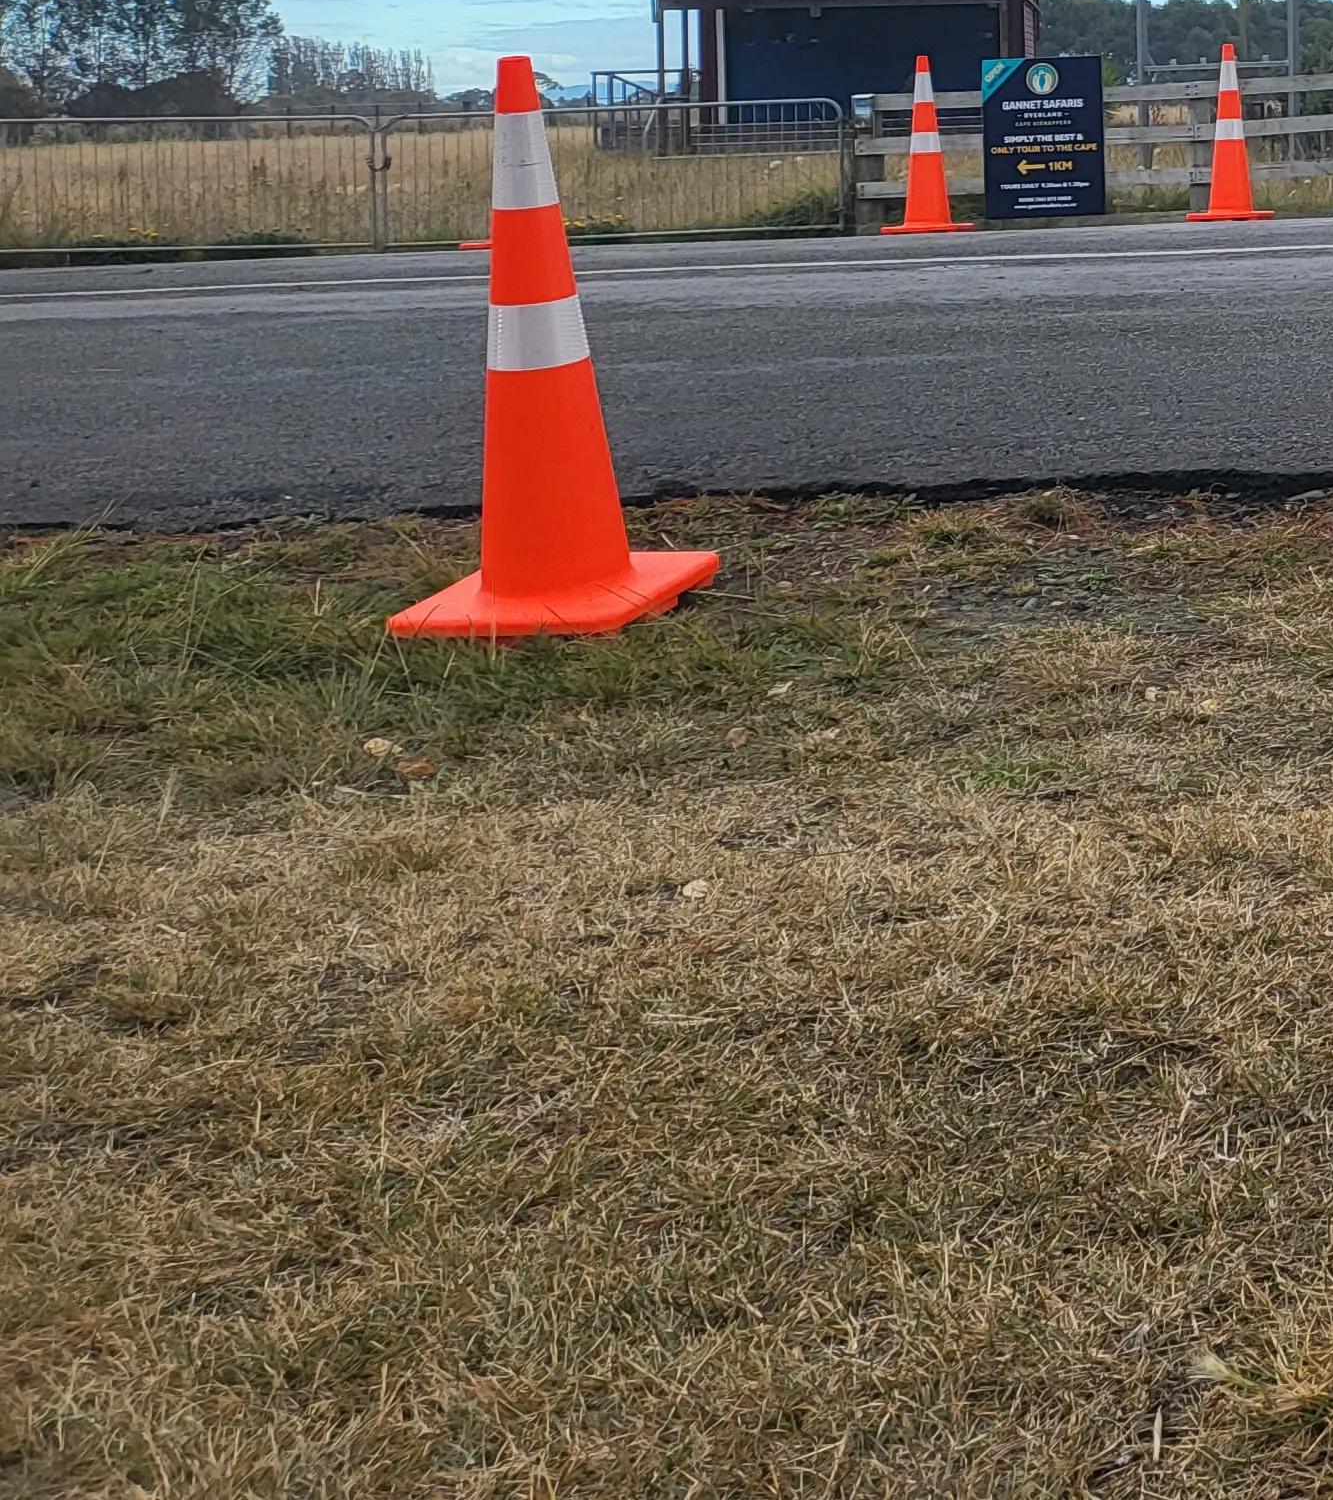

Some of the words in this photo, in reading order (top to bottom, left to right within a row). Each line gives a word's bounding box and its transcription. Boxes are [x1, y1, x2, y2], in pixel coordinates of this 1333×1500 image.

[1002, 100, 1041, 111] GANNET
[1042, 99, 1084, 109] SAFARIS
[1023, 111, 1062, 119] OVERLAND
[1004, 135, 1035, 143] SIMPLY
[1036, 134, 1053, 142] THE
[1054, 134, 1075, 142] BEST
[991, 146, 1015, 154] ONLY
[1016, 145, 1041, 153] TOUR
[1056, 144, 1073, 152] THE
[1074, 143, 1097, 151] CAPE
